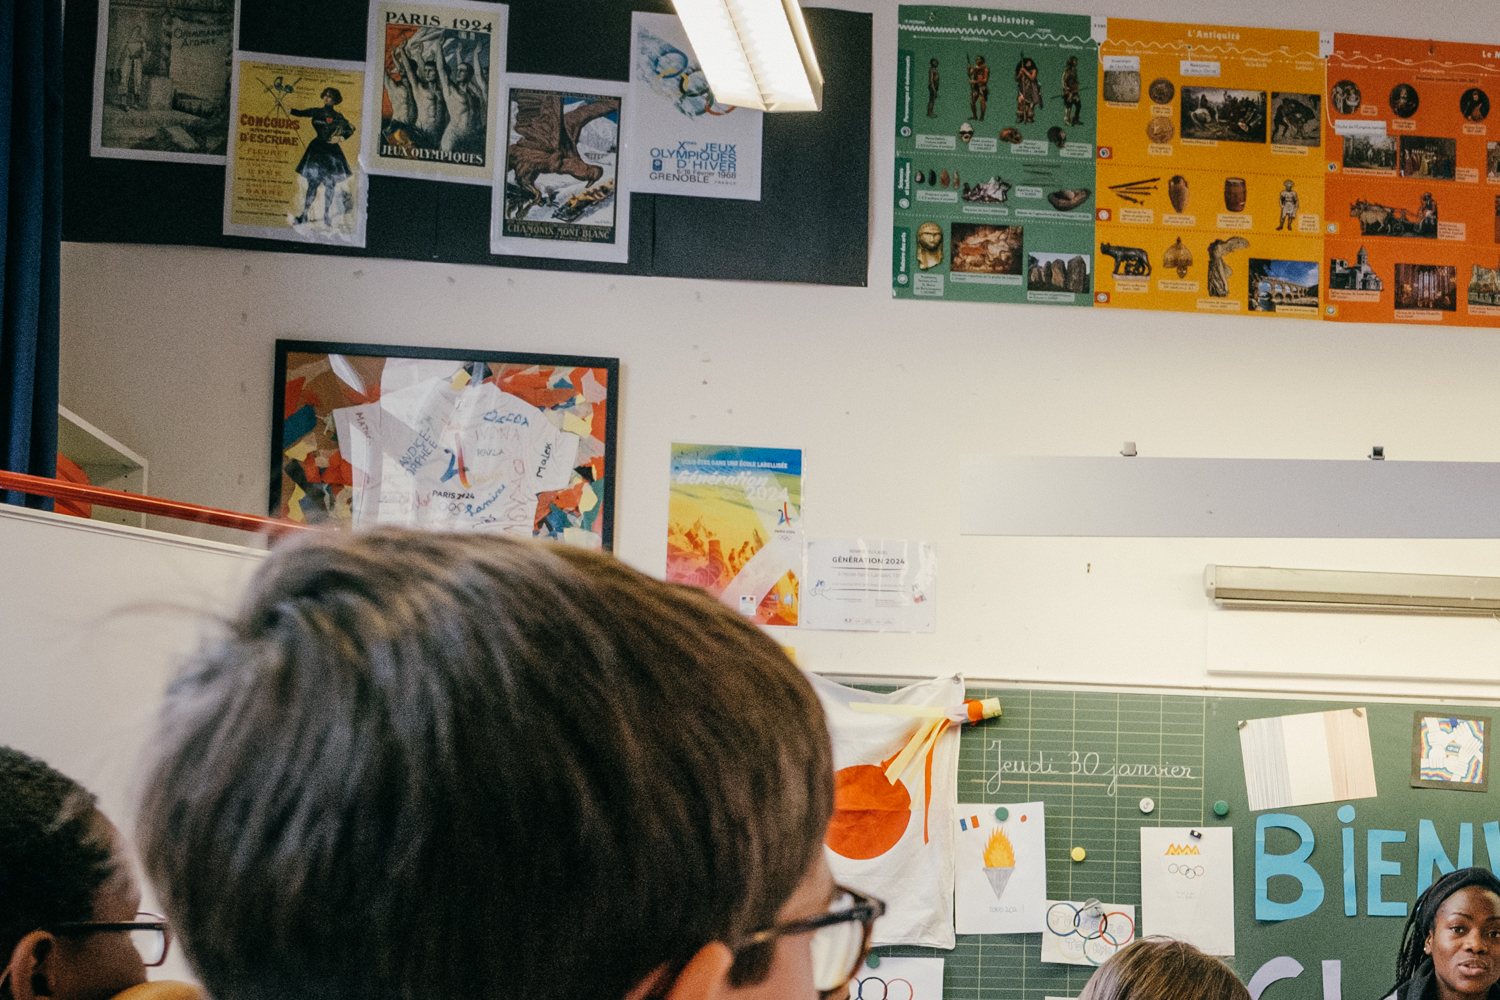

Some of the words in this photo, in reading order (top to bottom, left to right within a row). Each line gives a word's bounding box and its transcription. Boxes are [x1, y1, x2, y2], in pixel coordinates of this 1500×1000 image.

[386, 12, 441, 27] PARIS
[452, 18, 492, 32] 1924
[968, 13, 978, 21] La
[981, 14, 1035, 26] Préhistoire
[1188, 29, 1241, 41] L'Antiquité
[1482, 50, 1492, 59] Le
[240, 113, 300, 131] CONCOURS
[240, 132, 299, 147] D'ESCRIME
[381, 144, 409, 157] JEUX
[411, 148, 484, 165] OLYMPIQUES
[650, 147, 737, 162] OLYMPIQUES
[701, 143, 737, 154] JEUX
[676, 159, 737, 172] D'HIVER
[649, 171, 710, 184] GRENOBLE
[676, 469, 770, 486] Génération
[432, 489, 456, 500] PARIS
[745, 486, 789, 501] 2024
[986, 740, 1060, 795] Jeudi
[1068, 750, 1101, 776] 30
[1104, 757, 1196, 797] janvier
